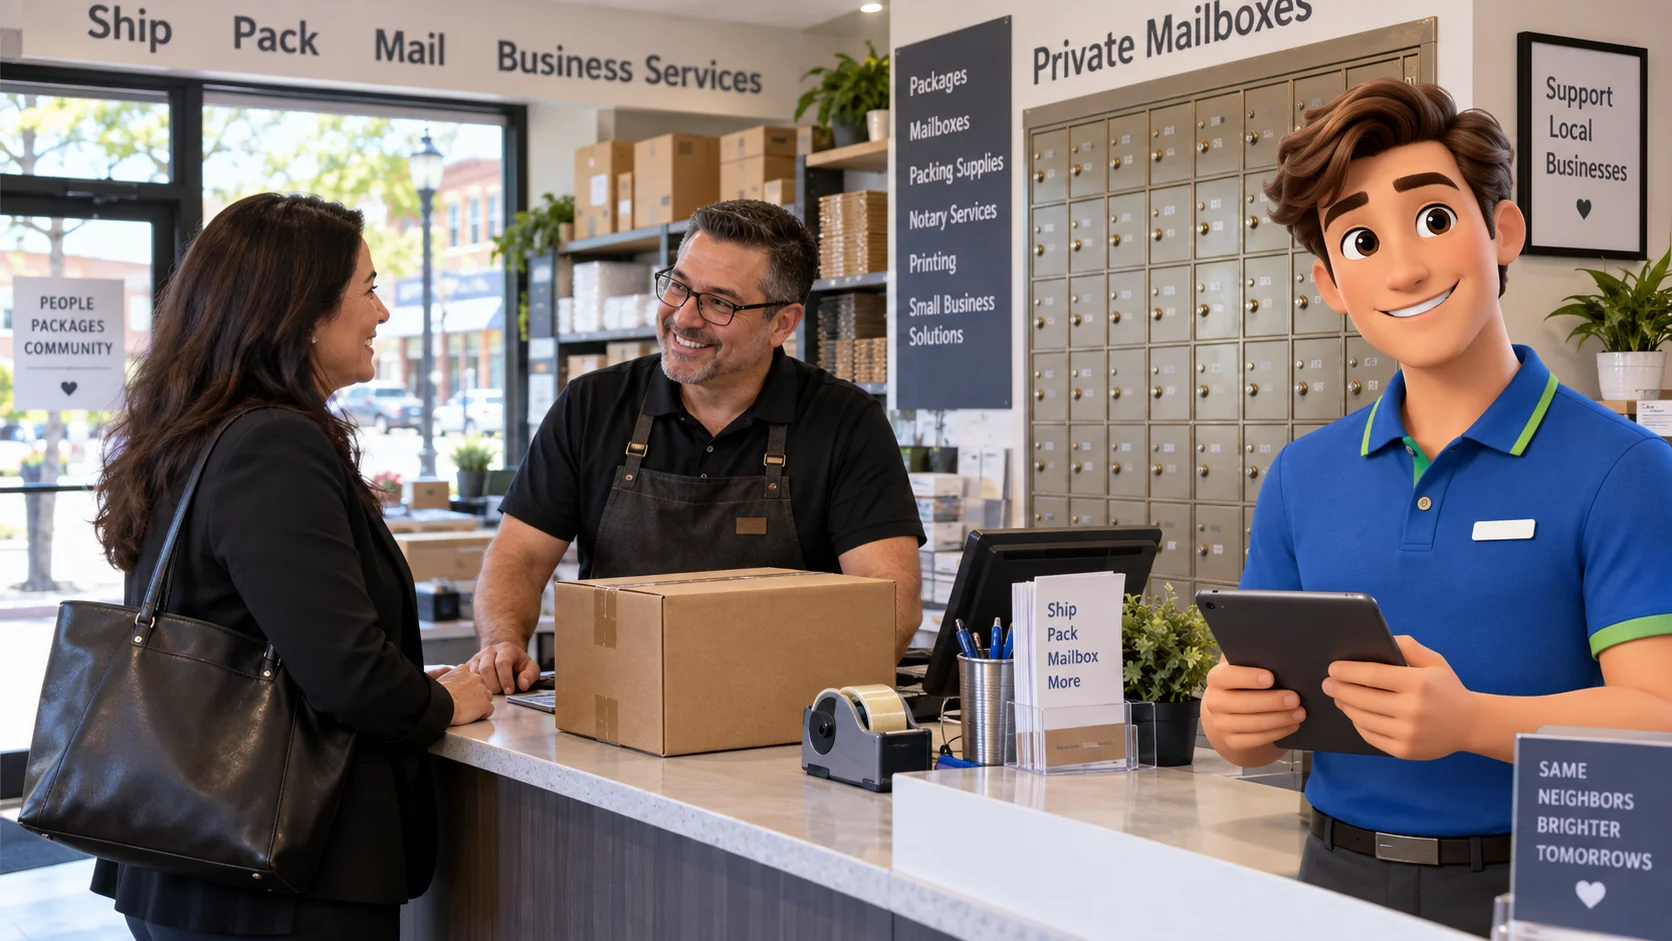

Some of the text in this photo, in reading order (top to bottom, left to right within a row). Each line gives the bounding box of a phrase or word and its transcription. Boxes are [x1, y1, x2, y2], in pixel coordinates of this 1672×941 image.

[87, 4, 763, 95] Ship Pack Mail Business Services
[1033, 0, 1313, 86] Private Mailboxes
[909, 68, 968, 97] Packages
[1546, 75, 1613, 110] Support
[909, 115, 970, 141] Mailboxes
[1549, 114, 1593, 142] Local
[909, 152, 1004, 186] Packing Supplies
[1546, 151, 1628, 182] Businesses
[909, 201, 998, 231] Notary Services
[909, 250, 957, 275] Printing
[40, 295, 94, 311] PEOPLE
[909, 292, 995, 317] Small Business
[31, 318, 105, 333] PACKAGES
[909, 325, 964, 347] Solutions
[24, 341, 113, 356] COMMUNITY
[1047, 601, 1077, 621] Ship
[1047, 625, 1078, 642] Pack
[1047, 649, 1099, 667] Mailbox
[1048, 674, 1081, 690] More
[1539, 760, 1587, 779] SAME
[1538, 788, 1635, 810] NEIGHBORS
[1537, 816, 1621, 838] BRIGHTER
[1536, 844, 1653, 871] TOMORROWS
